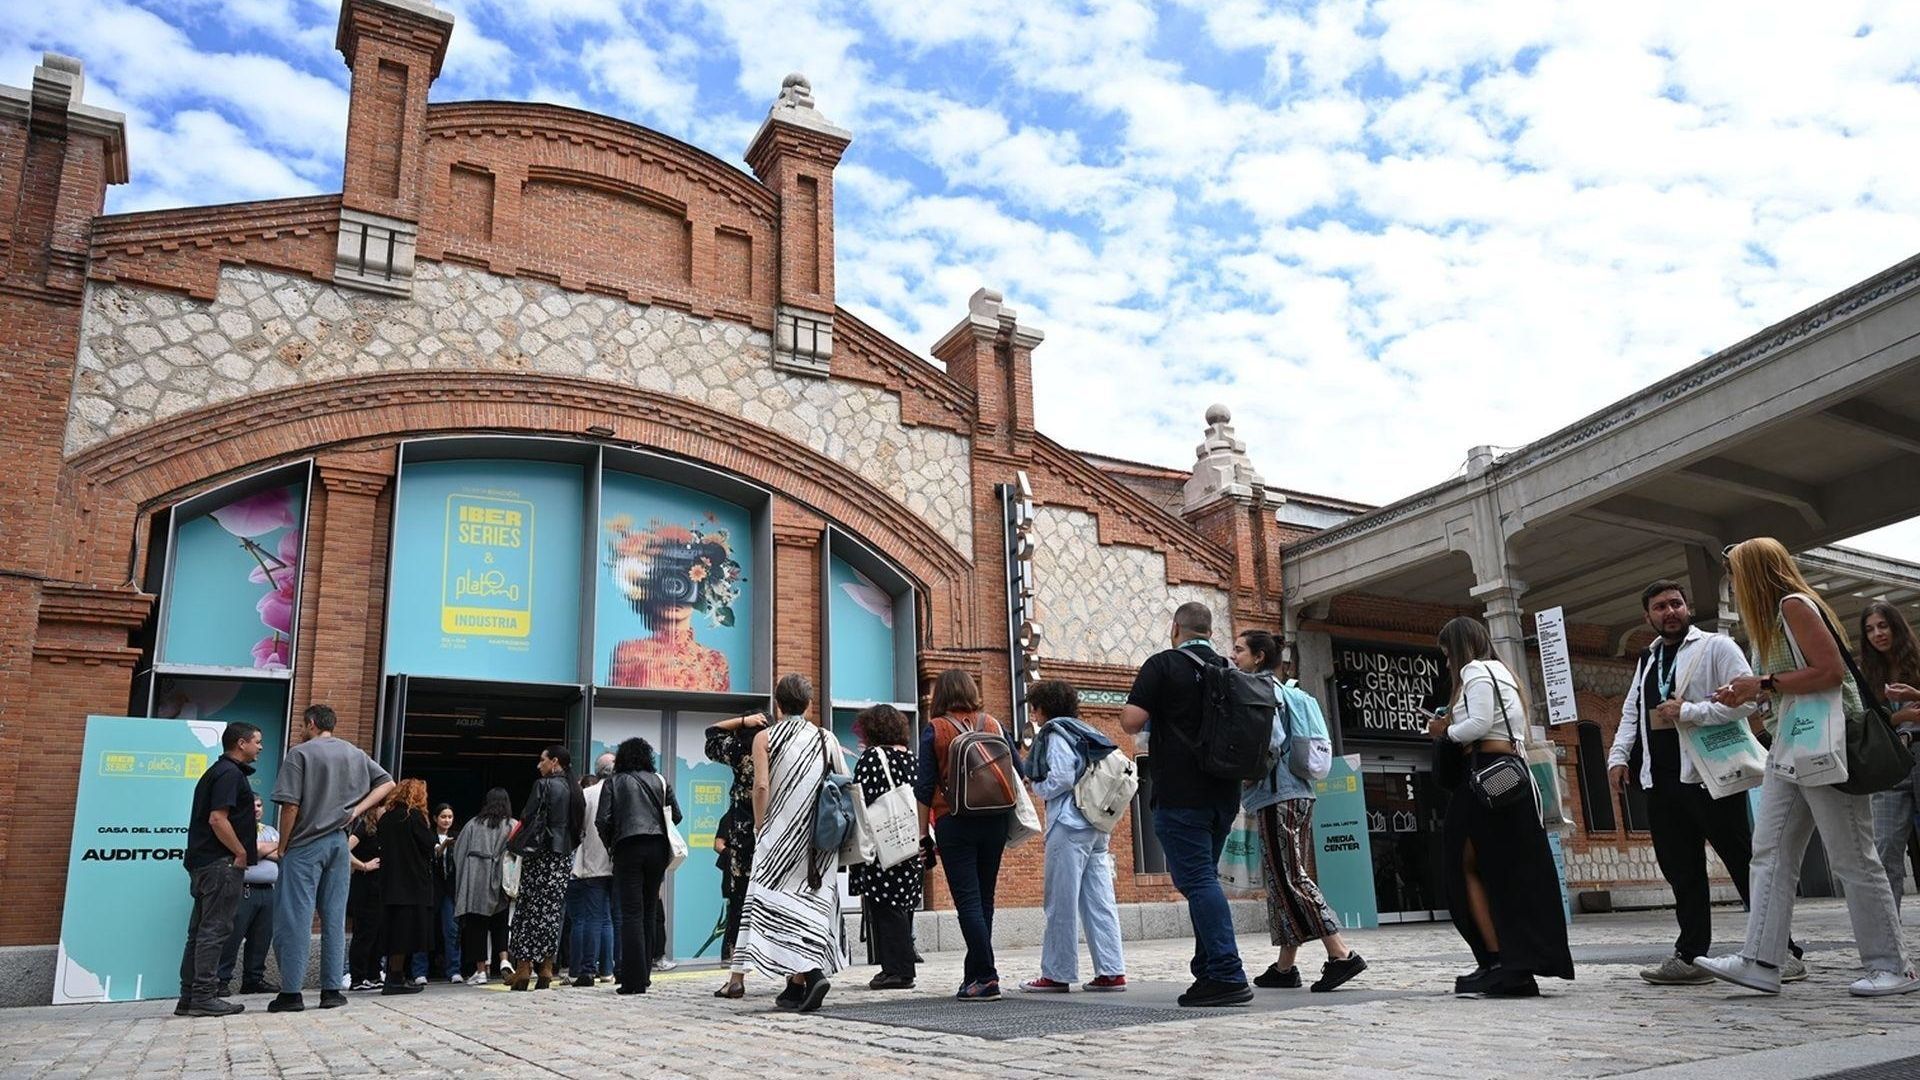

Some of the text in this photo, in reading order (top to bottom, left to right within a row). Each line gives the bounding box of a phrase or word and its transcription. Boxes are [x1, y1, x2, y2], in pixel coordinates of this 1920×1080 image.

[459, 505, 522, 527] IBER
[458, 522, 521, 548] SERIES
[483, 552, 495, 564] &
[455, 614, 518, 629] INDUSTRIA
[1343, 651, 1440, 677] FUNDACIÓN
[1365, 672, 1434, 695] GERMÁN
[98, 826, 129, 834] CASA
[1326, 834, 1355, 843] MEDIA
[1323, 842, 1360, 852] CENTER
